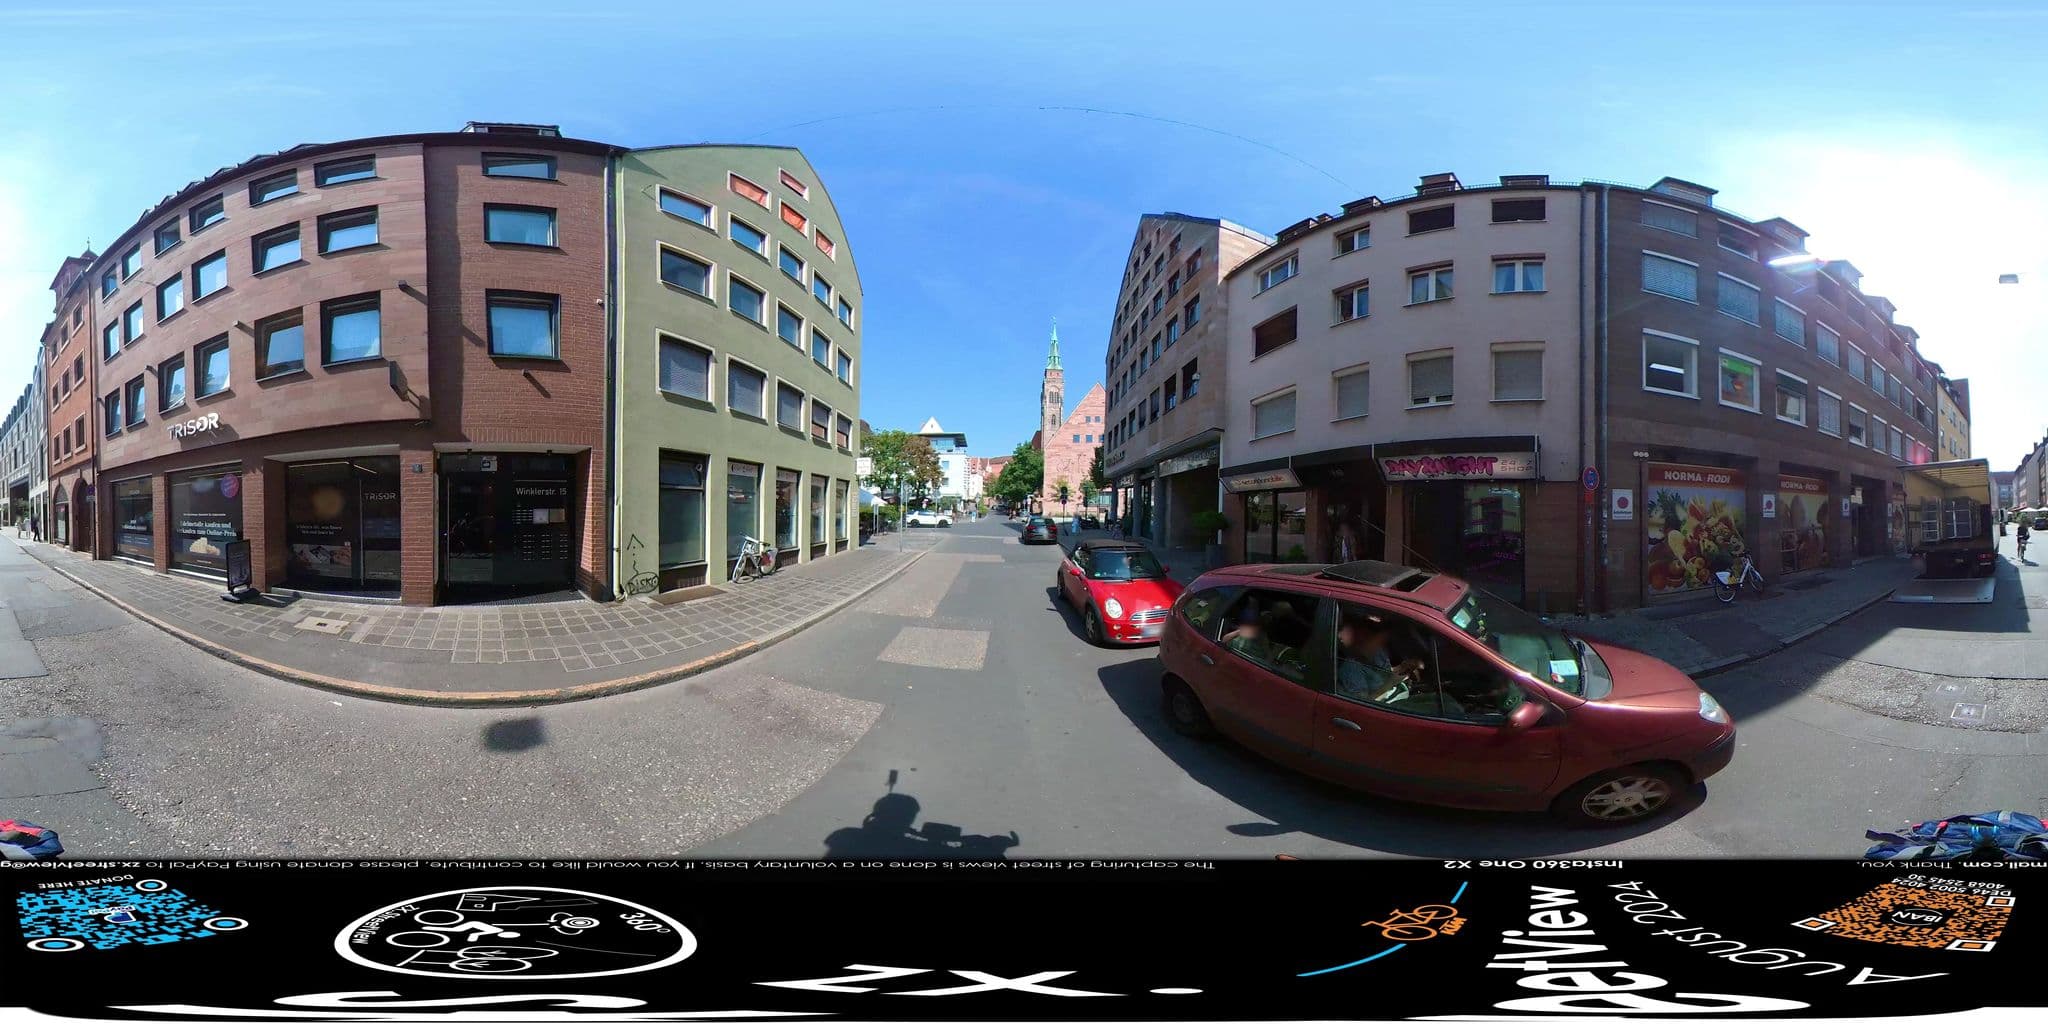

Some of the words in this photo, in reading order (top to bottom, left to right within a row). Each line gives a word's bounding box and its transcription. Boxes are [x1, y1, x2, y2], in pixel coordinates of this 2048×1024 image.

[1664, 470, 1702, 482] NORMA
[1707, 473, 1731, 484] RODI
[1780, 481, 1803, 490] NORMA
[515, 487, 557, 496] Winklerstr.
[560, 487, 567, 495] 15
